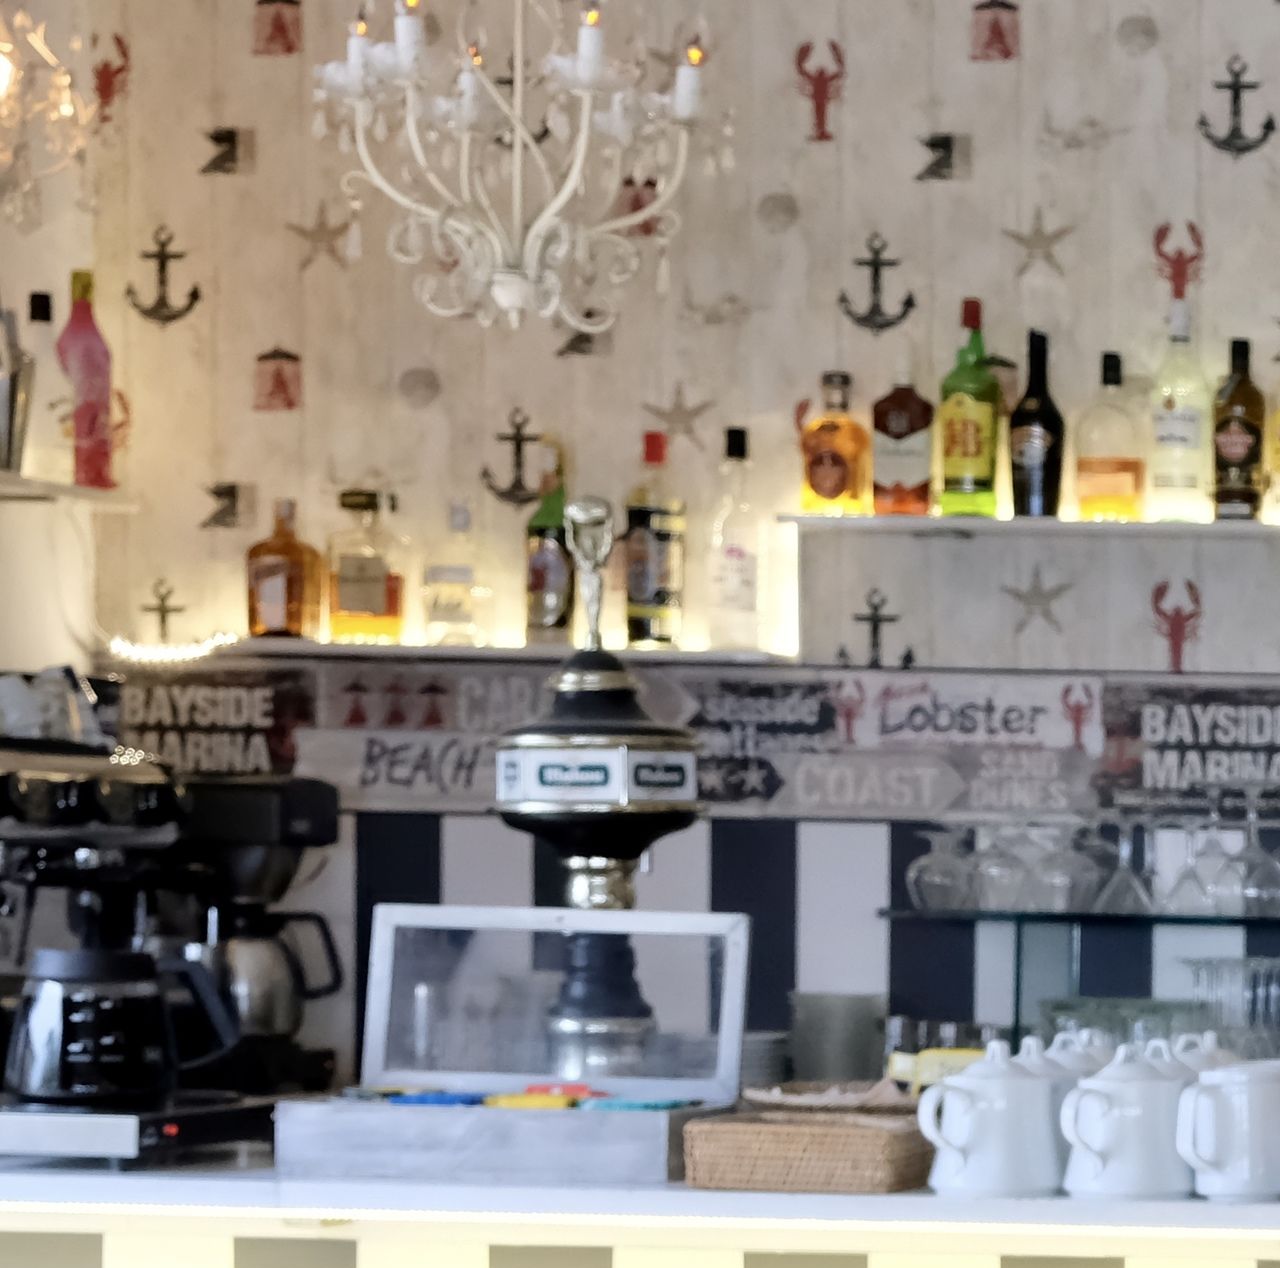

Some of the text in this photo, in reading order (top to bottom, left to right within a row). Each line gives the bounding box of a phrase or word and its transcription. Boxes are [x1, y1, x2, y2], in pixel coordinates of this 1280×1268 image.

[122, 686, 275, 728] BAYSIDE
[878, 689, 1050, 735] Lobster
[360, 736, 483, 794] BEACH
[794, 756, 941, 809] COAST
